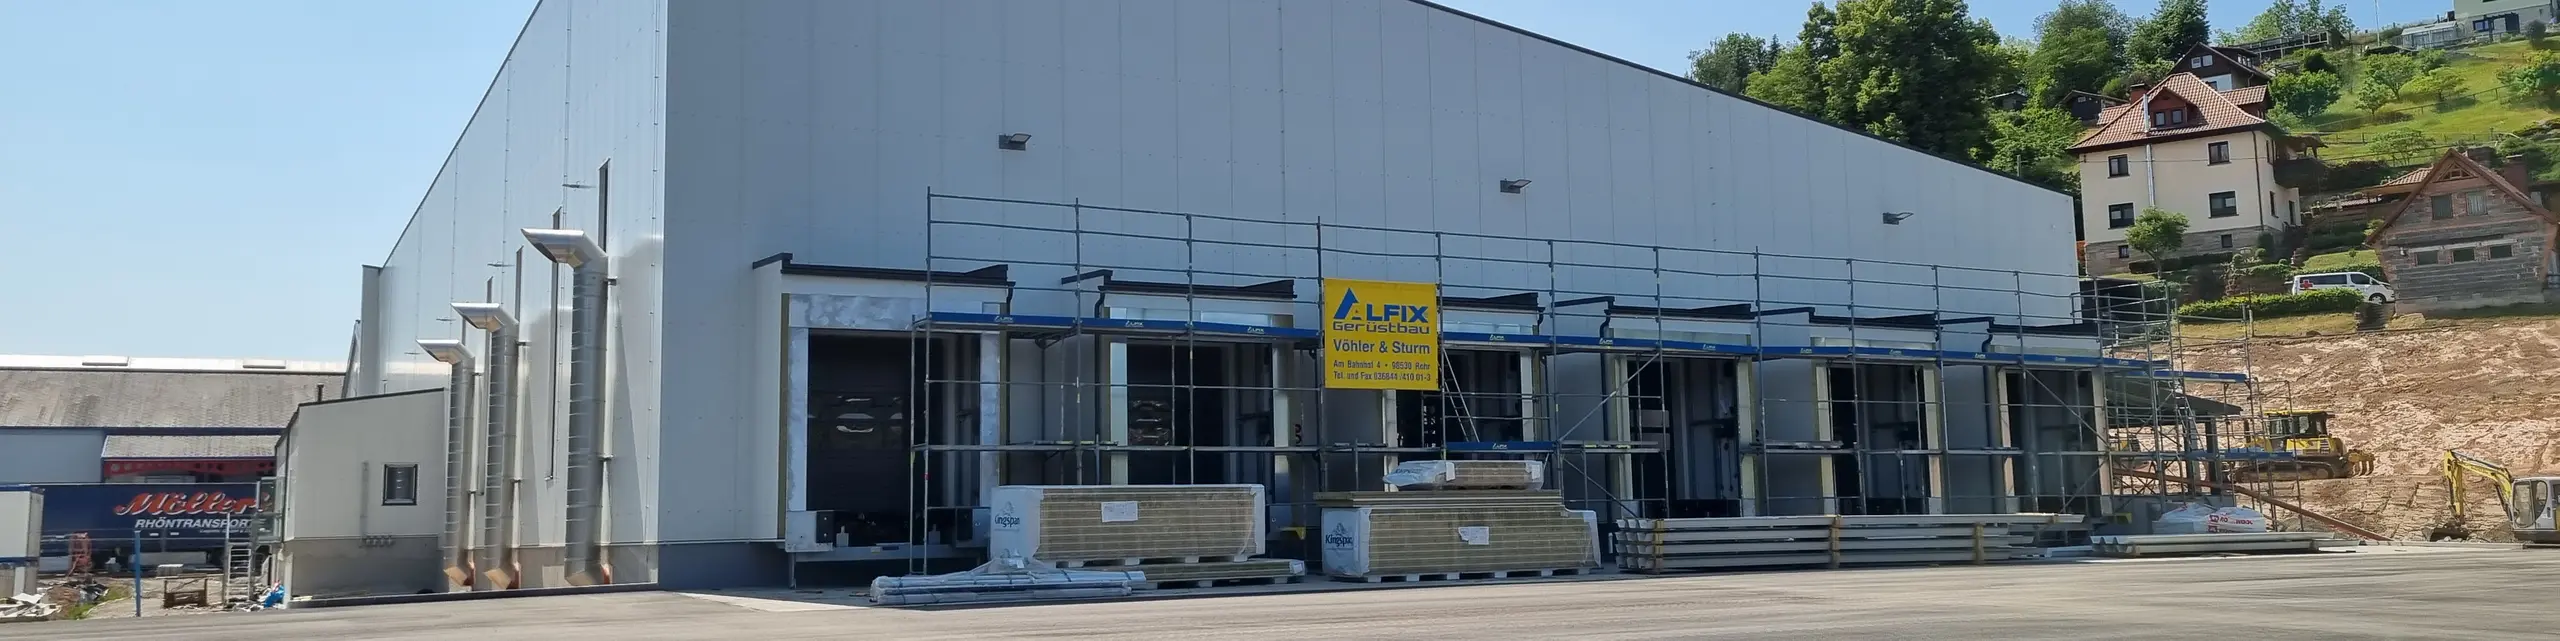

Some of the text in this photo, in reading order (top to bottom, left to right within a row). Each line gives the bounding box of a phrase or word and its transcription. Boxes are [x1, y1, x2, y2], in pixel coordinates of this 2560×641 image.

[1333, 287, 1429, 323] ALFIX
[1333, 321, 1430, 335] Gerüstbau
[1333, 339, 1430, 354] Vöhler & Sturm
[1333, 360, 1344, 368] Am
[1377, 361, 1381, 369] 4
[1415, 362, 1430, 371] Rohr
[1347, 372, 1359, 380] und
[1360, 372, 1372, 380] Fax
